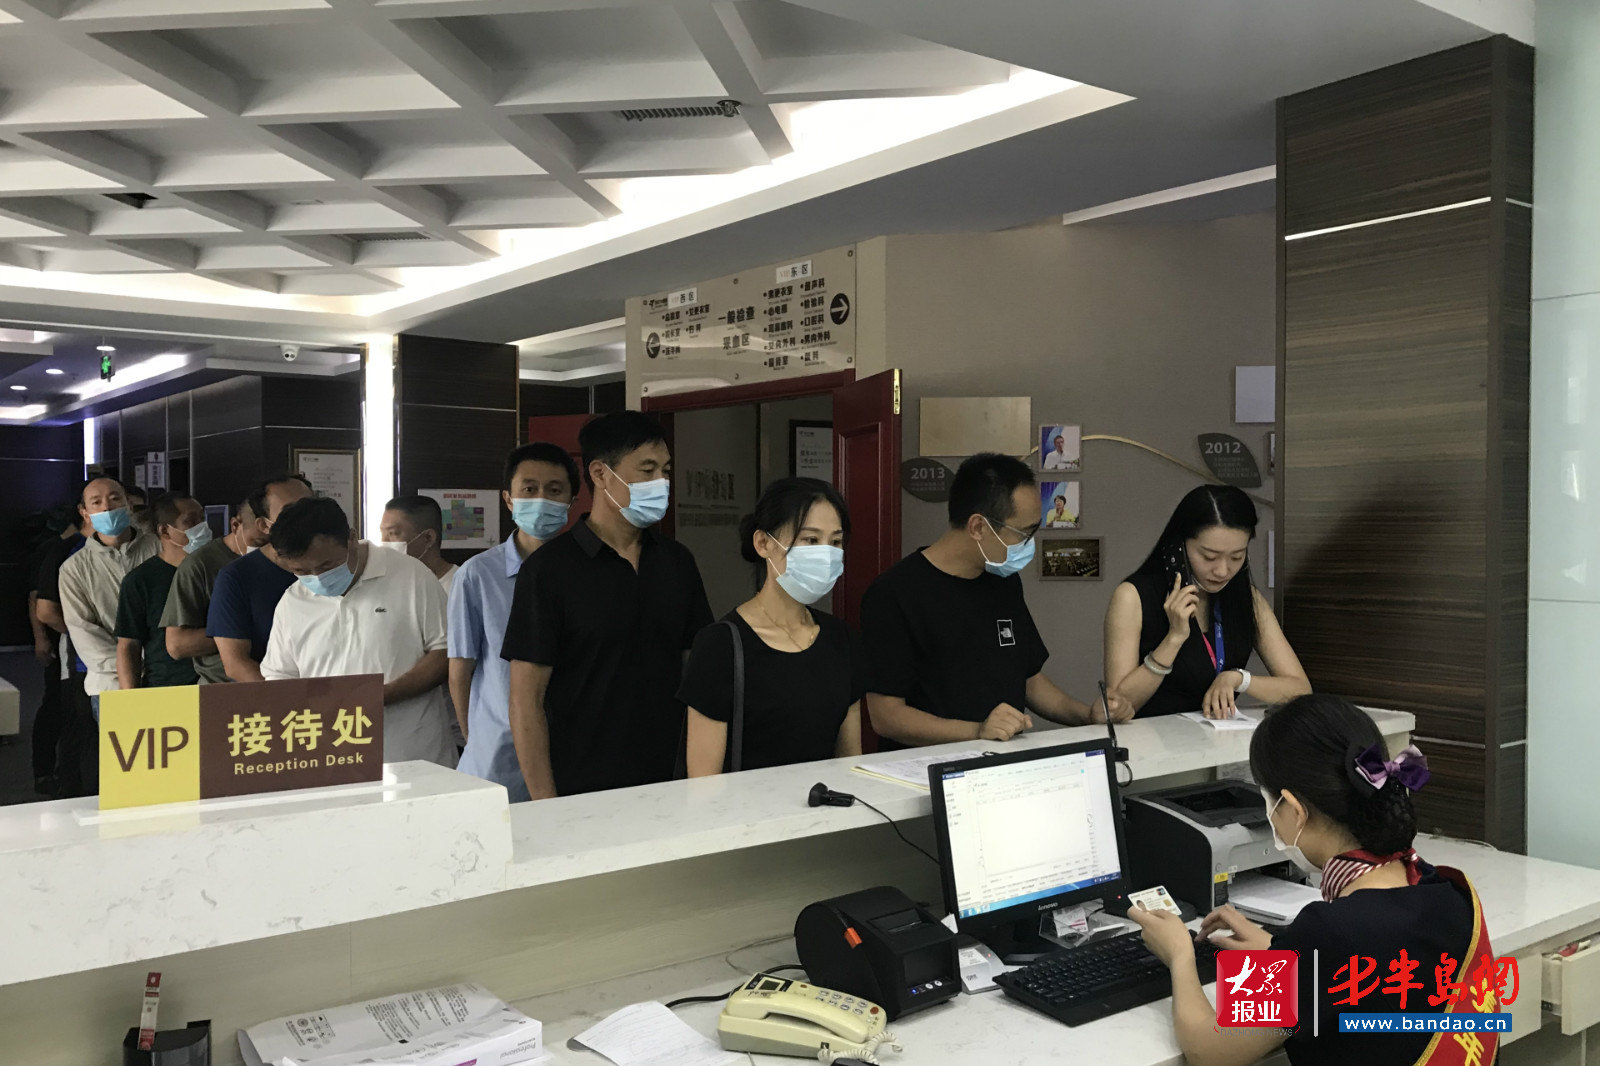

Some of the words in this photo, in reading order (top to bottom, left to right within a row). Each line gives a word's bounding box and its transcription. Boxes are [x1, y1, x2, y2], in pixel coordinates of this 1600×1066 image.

[791, 264, 809, 278] 东区
[680, 291, 695, 303] 西区
[718, 306, 755, 324] 一般检查
[768, 304, 788, 316] 心电图
[804, 314, 824, 326] 口腔科
[723, 333, 750, 350] 采血区
[1205, 442, 1241, 454] 2012
[911, 467, 945, 480] 2013
[227, 706, 373, 757] 接待处
[108, 726, 189, 772] VIP
[234, 757, 318, 775] Reception
[326, 752, 364, 767] Desk
[1038, 902, 1058, 911] lenovo
